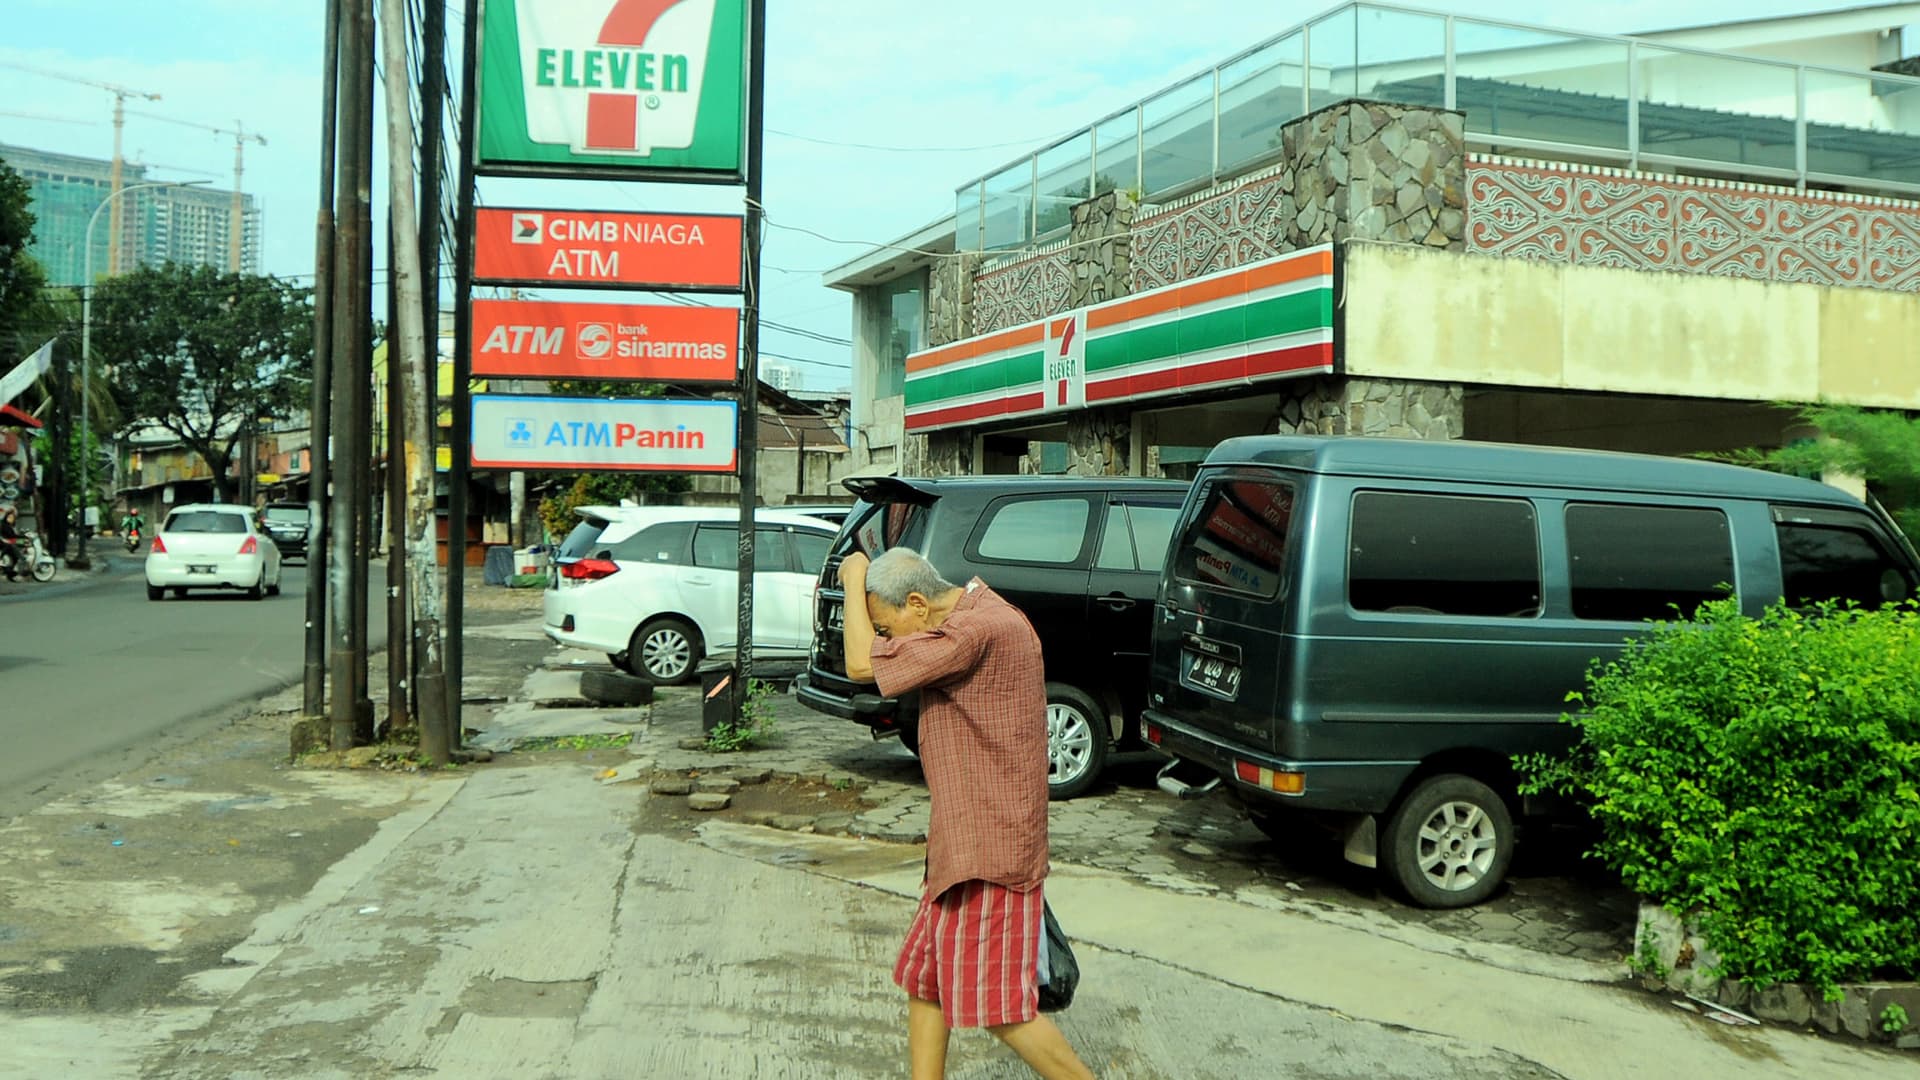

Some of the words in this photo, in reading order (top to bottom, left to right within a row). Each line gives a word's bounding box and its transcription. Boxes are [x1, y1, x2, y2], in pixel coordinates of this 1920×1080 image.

[549, 219, 618, 243] CIMB
[623, 222, 704, 245] NIAGA
[548, 249, 619, 277] ATM
[480, 325, 565, 355] ATM
[616, 337, 727, 360] sinarmas
[617, 323, 648, 336] bank
